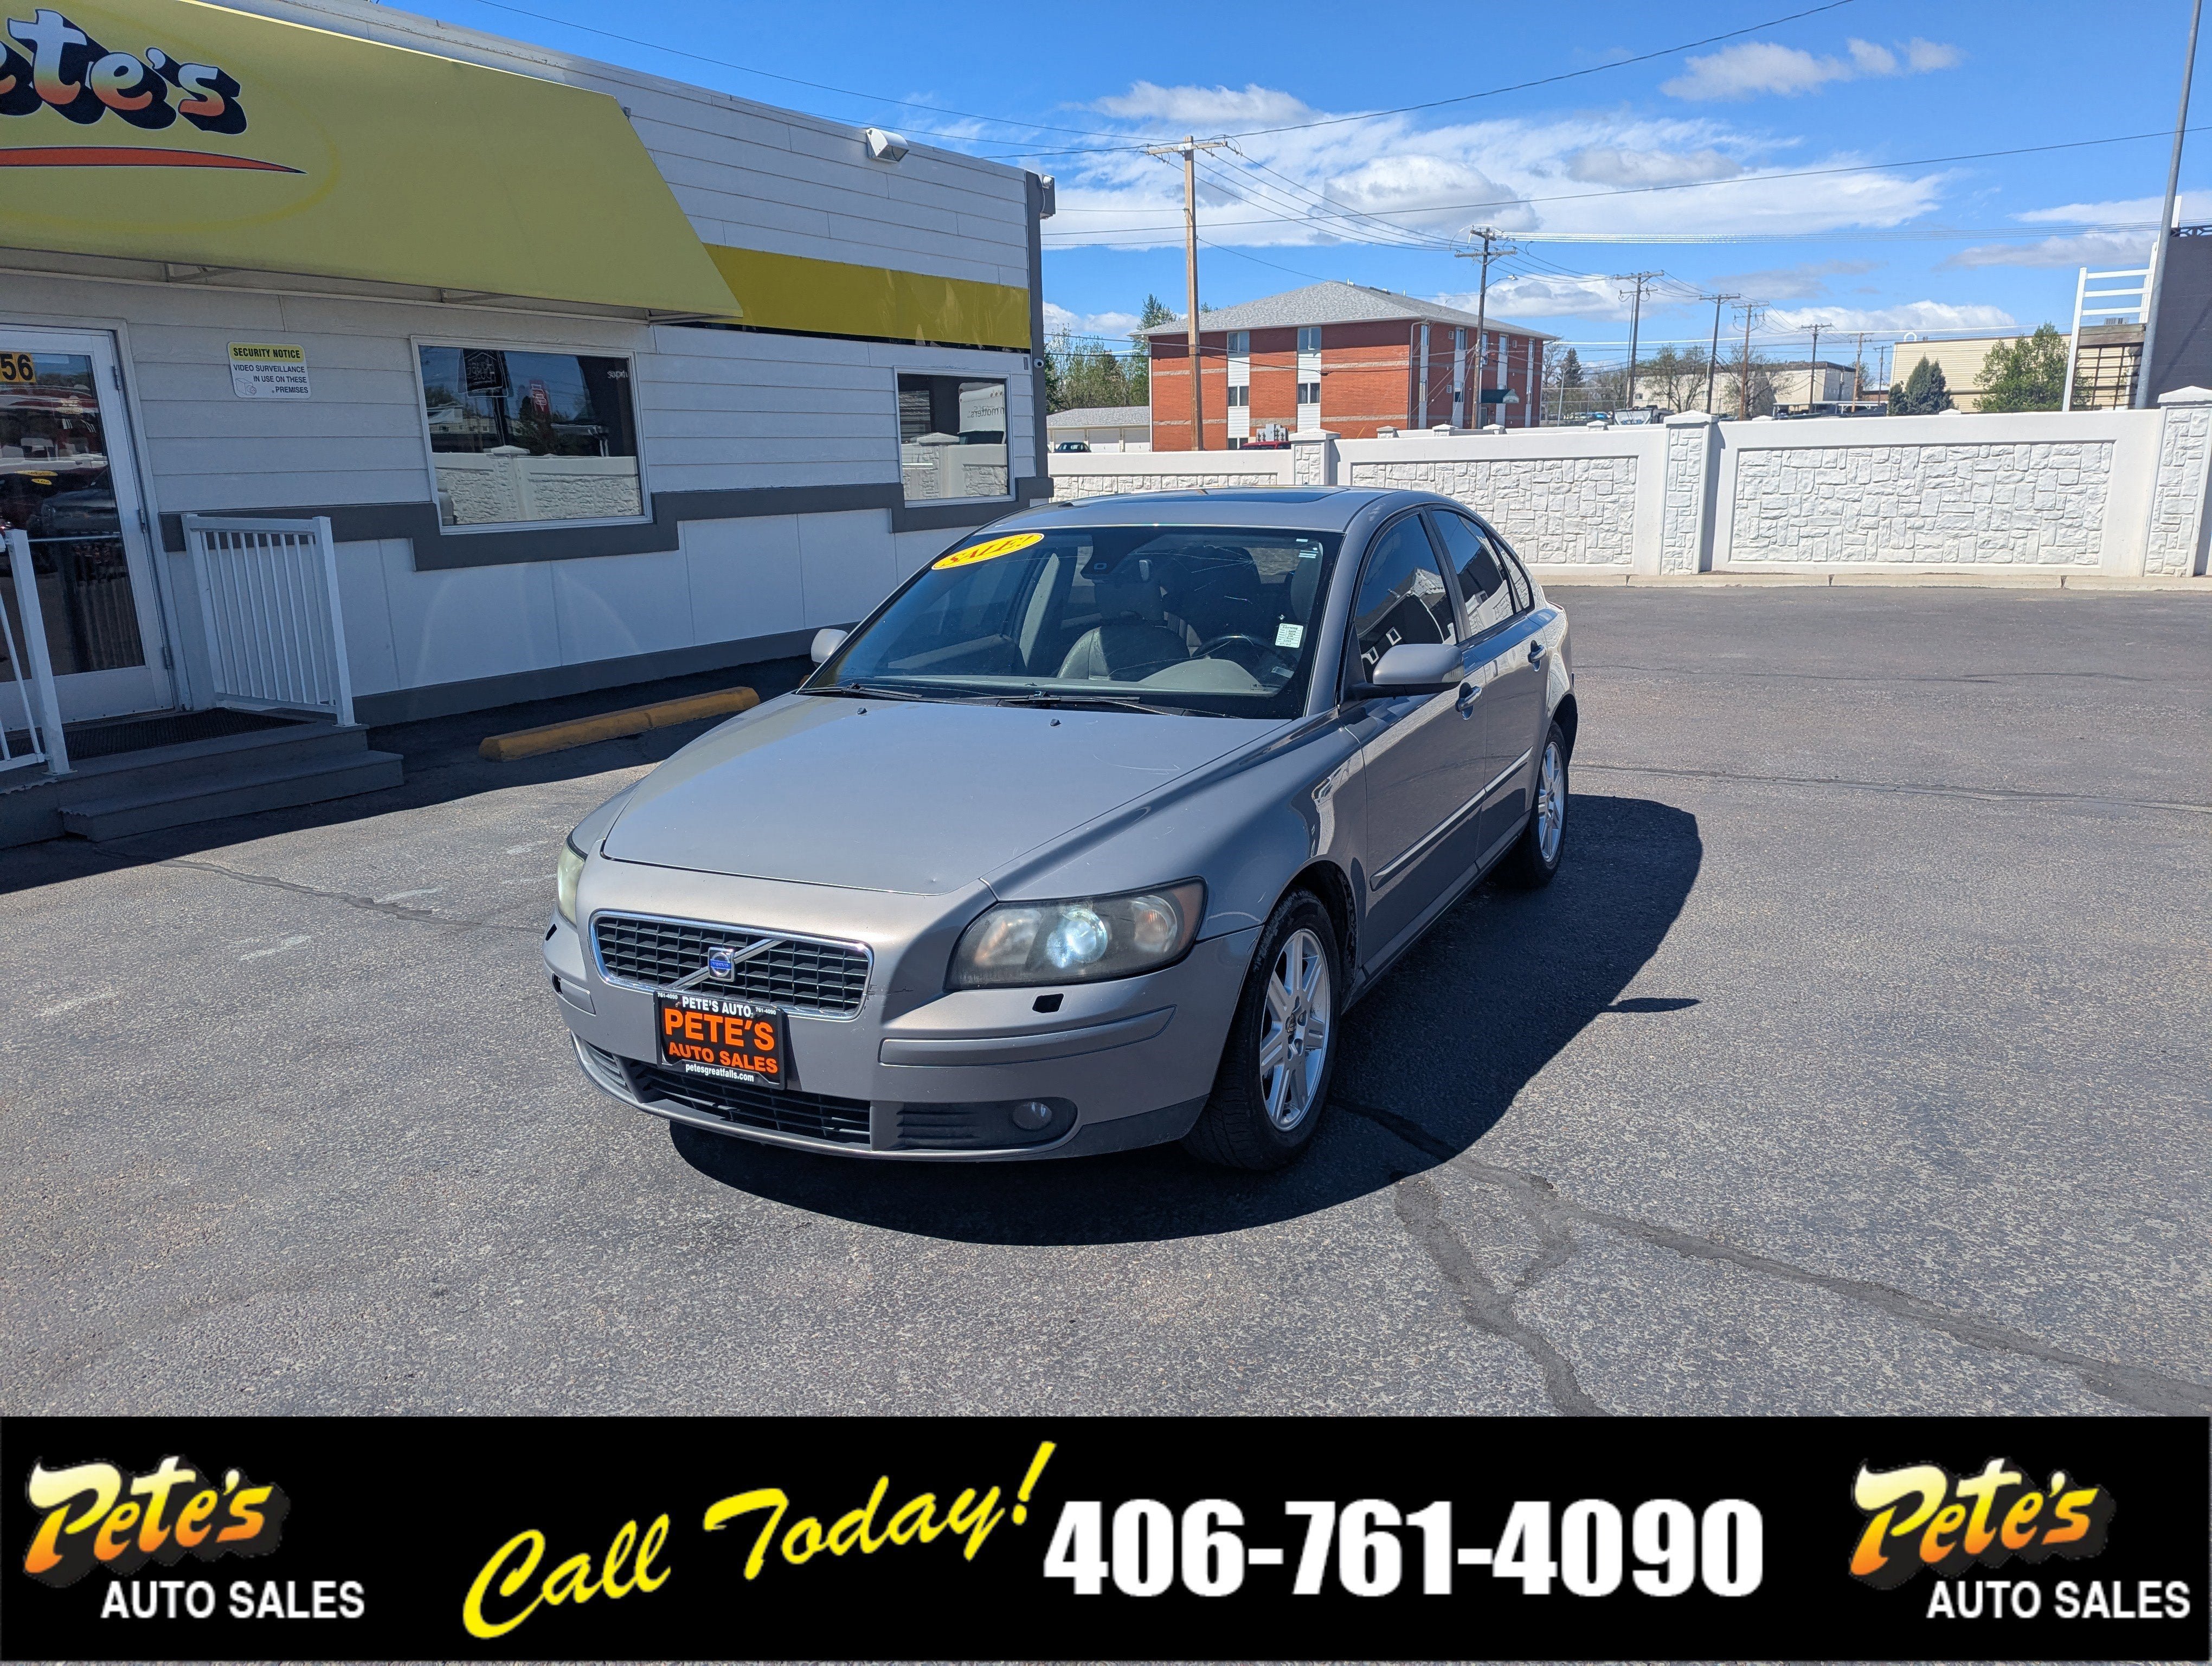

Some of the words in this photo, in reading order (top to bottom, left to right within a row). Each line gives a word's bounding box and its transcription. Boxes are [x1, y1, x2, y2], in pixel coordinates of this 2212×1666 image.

[0, 8, 239, 130] te's
[233, 348, 270, 357] SECURITY
[273, 349, 300, 358] NOTICE
[256, 365, 305, 373] SURVEILLANCE
[941, 535, 1034, 567] SALE!
[682, 996, 719, 1013] PETE'S
[722, 1002, 751, 1018] AUTO
[755, 1007, 776, 1015] 761-4090
[665, 1008, 775, 1050] PETE'S
[669, 1042, 715, 1063] AUTO
[719, 1050, 778, 1073] SALES
[685, 1063, 754, 1082] petesgreatfalls.com
